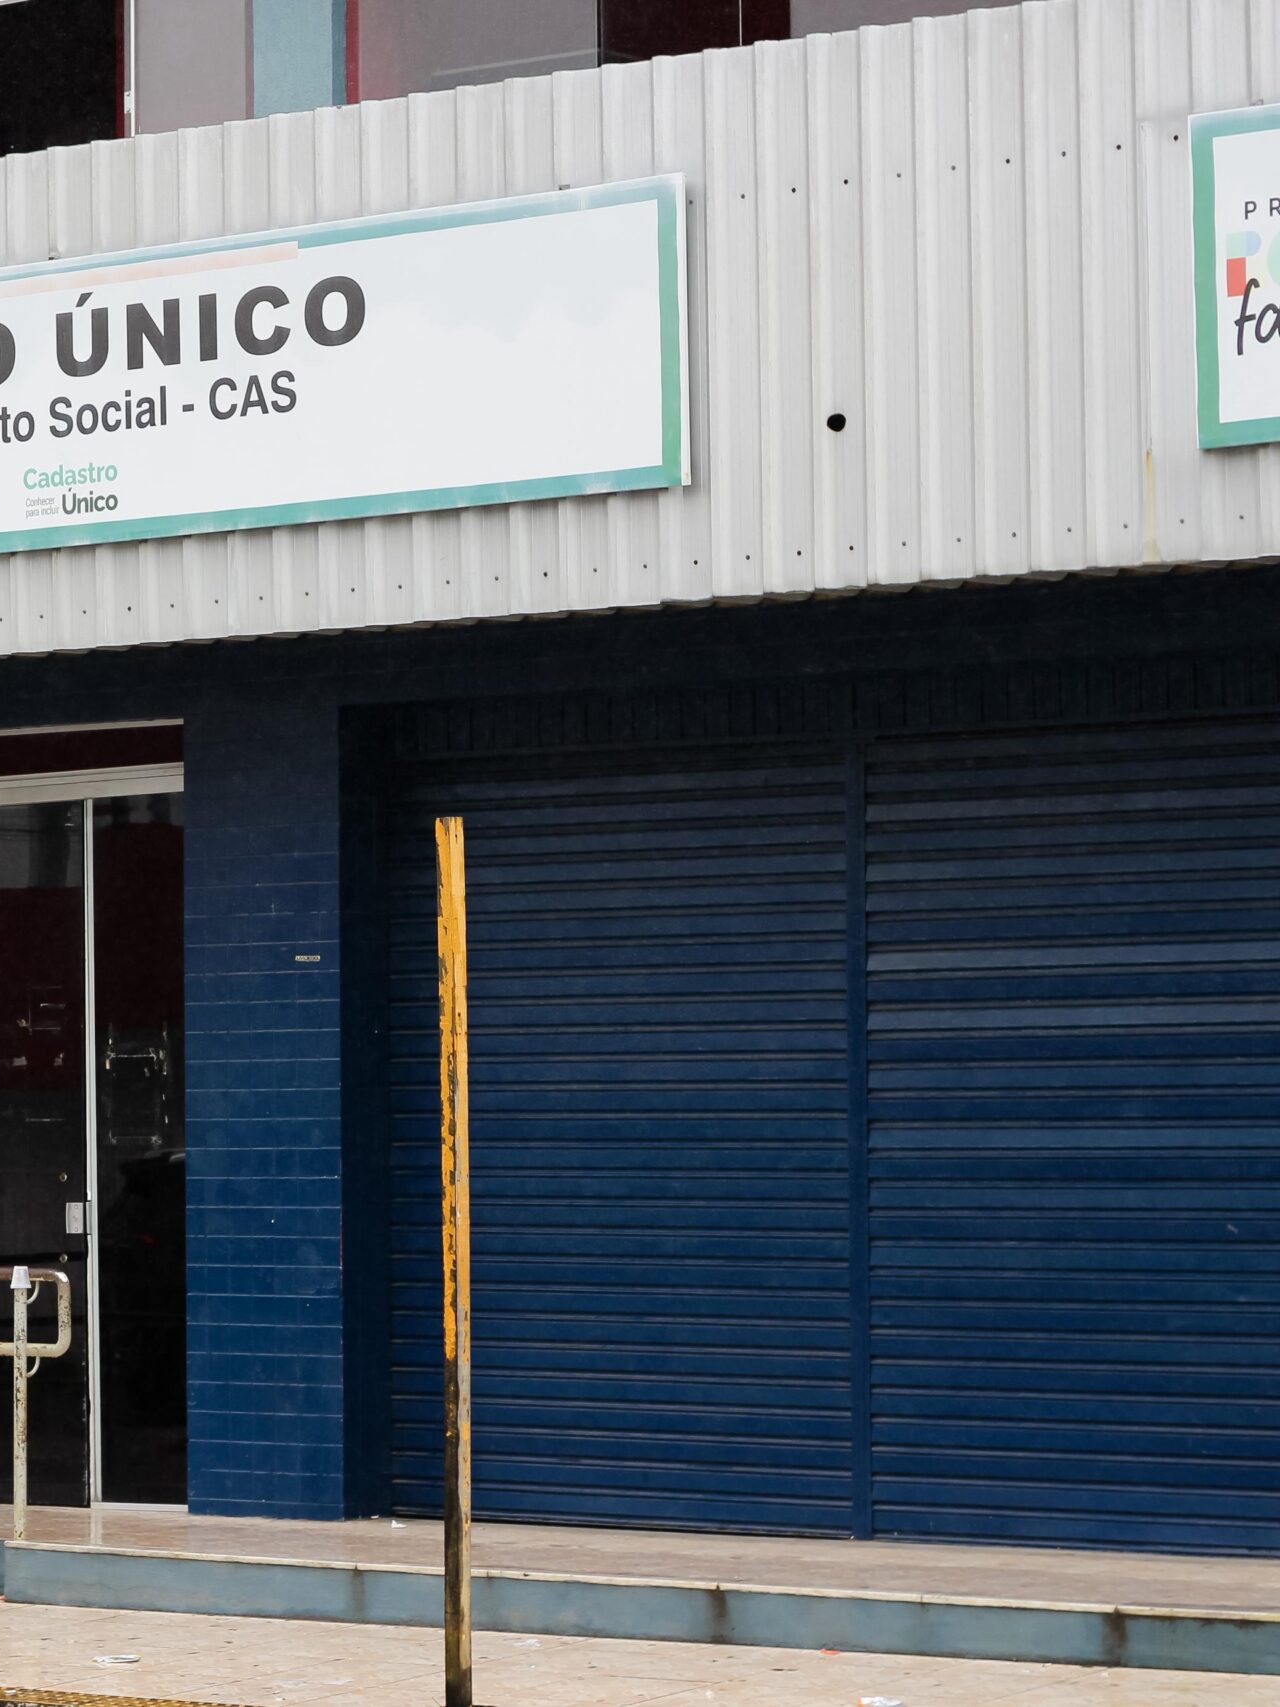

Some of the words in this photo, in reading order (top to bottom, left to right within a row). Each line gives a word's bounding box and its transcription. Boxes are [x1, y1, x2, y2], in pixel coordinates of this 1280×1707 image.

[55, 275, 366, 378] ÚNICO
[49, 385, 167, 438] Social
[208, 370, 297, 421] CAS
[23, 462, 118, 490] Cadastro
[61, 487, 119, 515] Único
